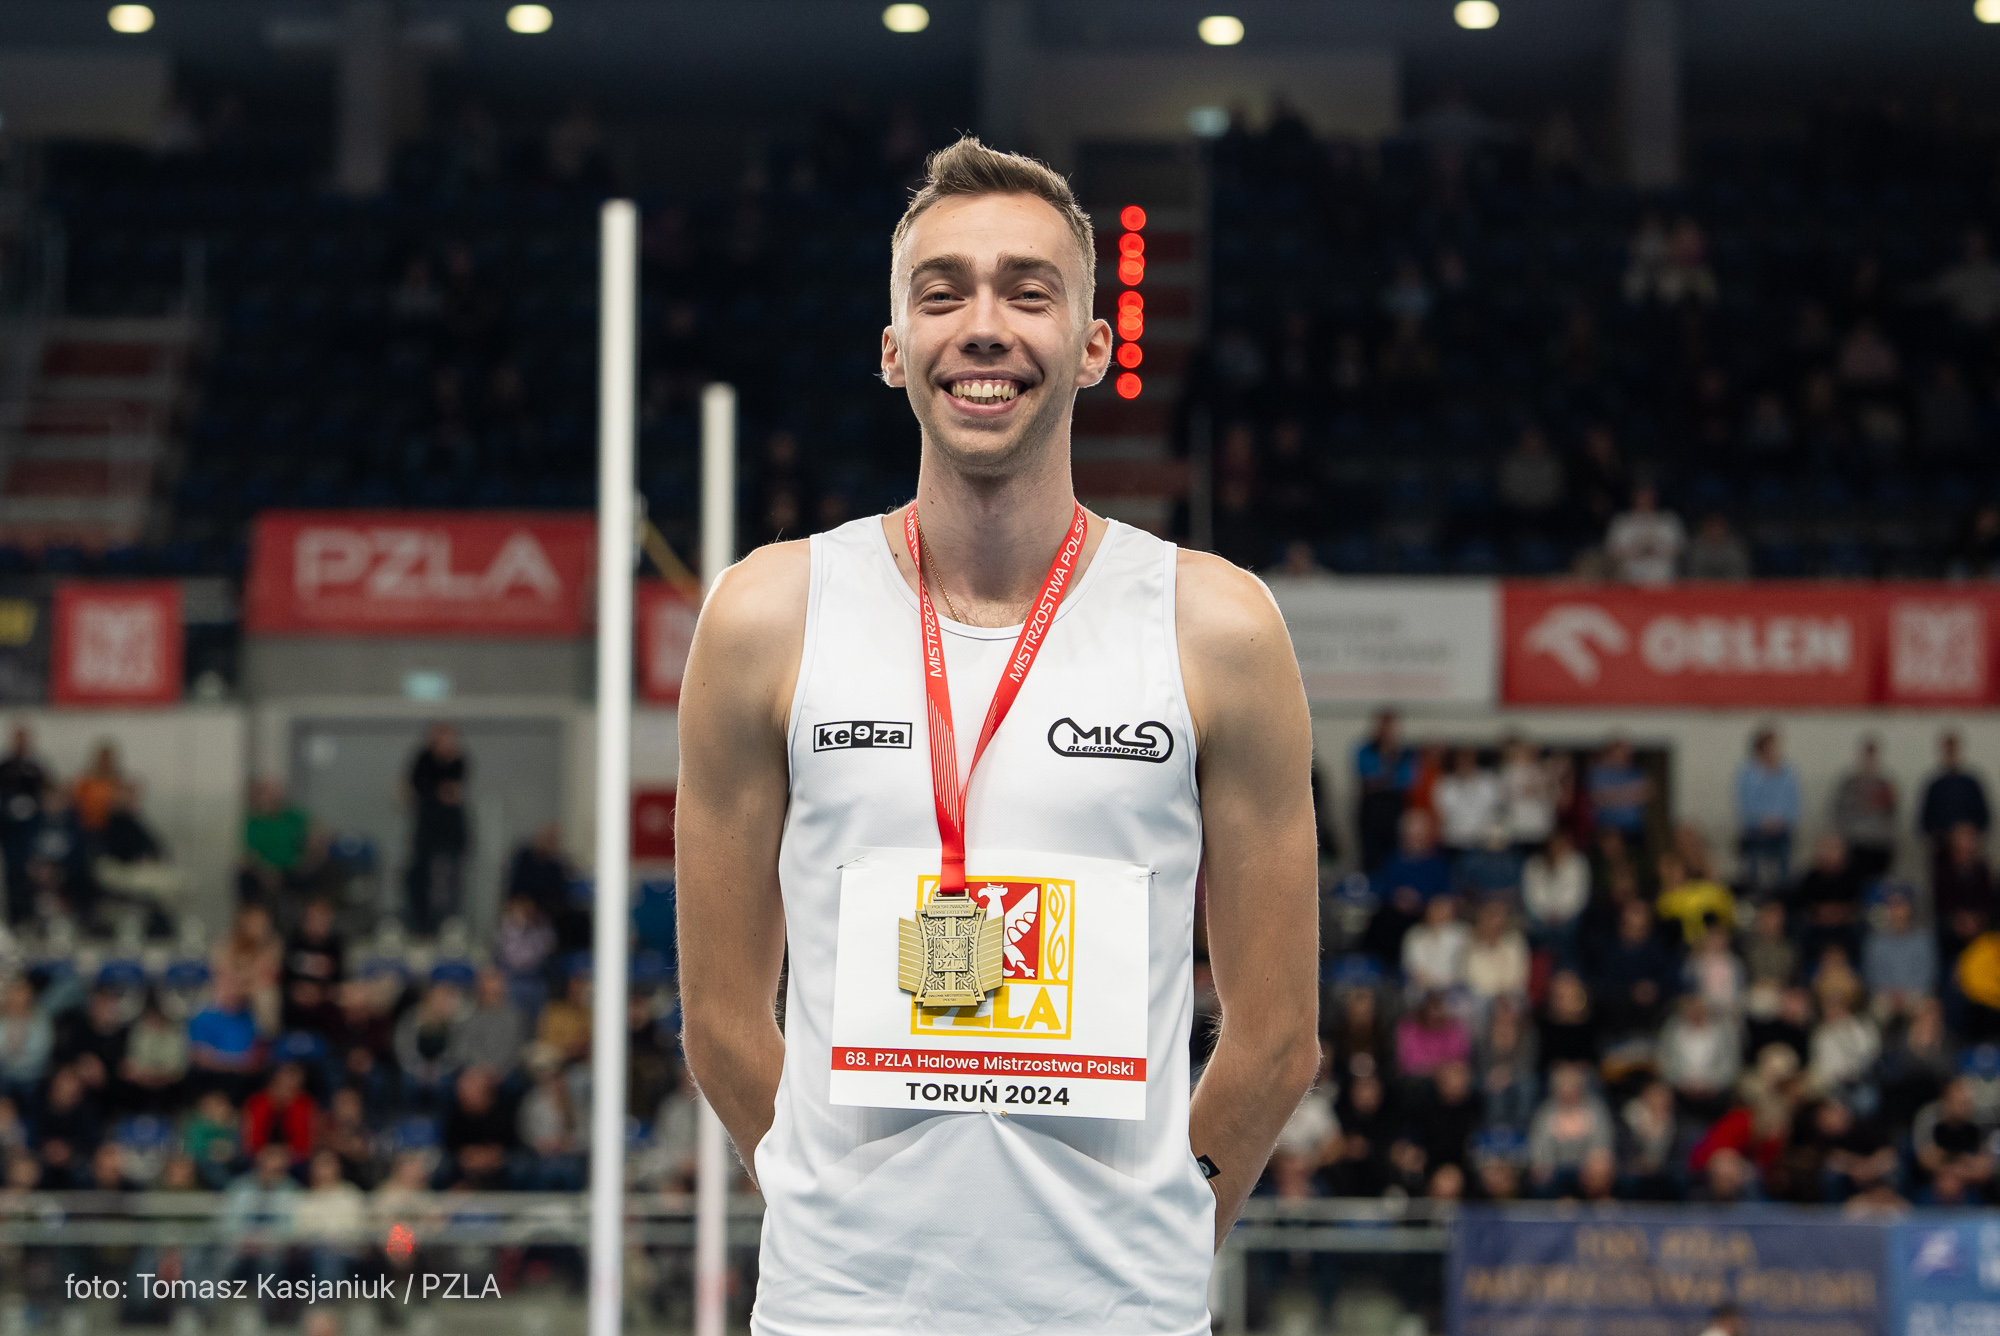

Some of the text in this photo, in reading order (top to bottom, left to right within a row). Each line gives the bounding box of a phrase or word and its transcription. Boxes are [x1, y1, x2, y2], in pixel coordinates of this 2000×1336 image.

[295, 529, 561, 598] PZLA
[1009, 510, 1085, 683] MISTRZOSTWA POLSKI
[1641, 615, 1854, 675] ORLEN
[818, 724, 905, 747] keeza
[1067, 745, 1160, 757] ALEKSANDRÓW
[935, 959, 967, 970] PZLA
[920, 985, 1062, 1030] ZLA
[845, 1051, 1134, 1076] 68. PZLA Halowe Mistrzostwa Polski
[906, 1079, 1070, 1105] TORUŃ 2024
